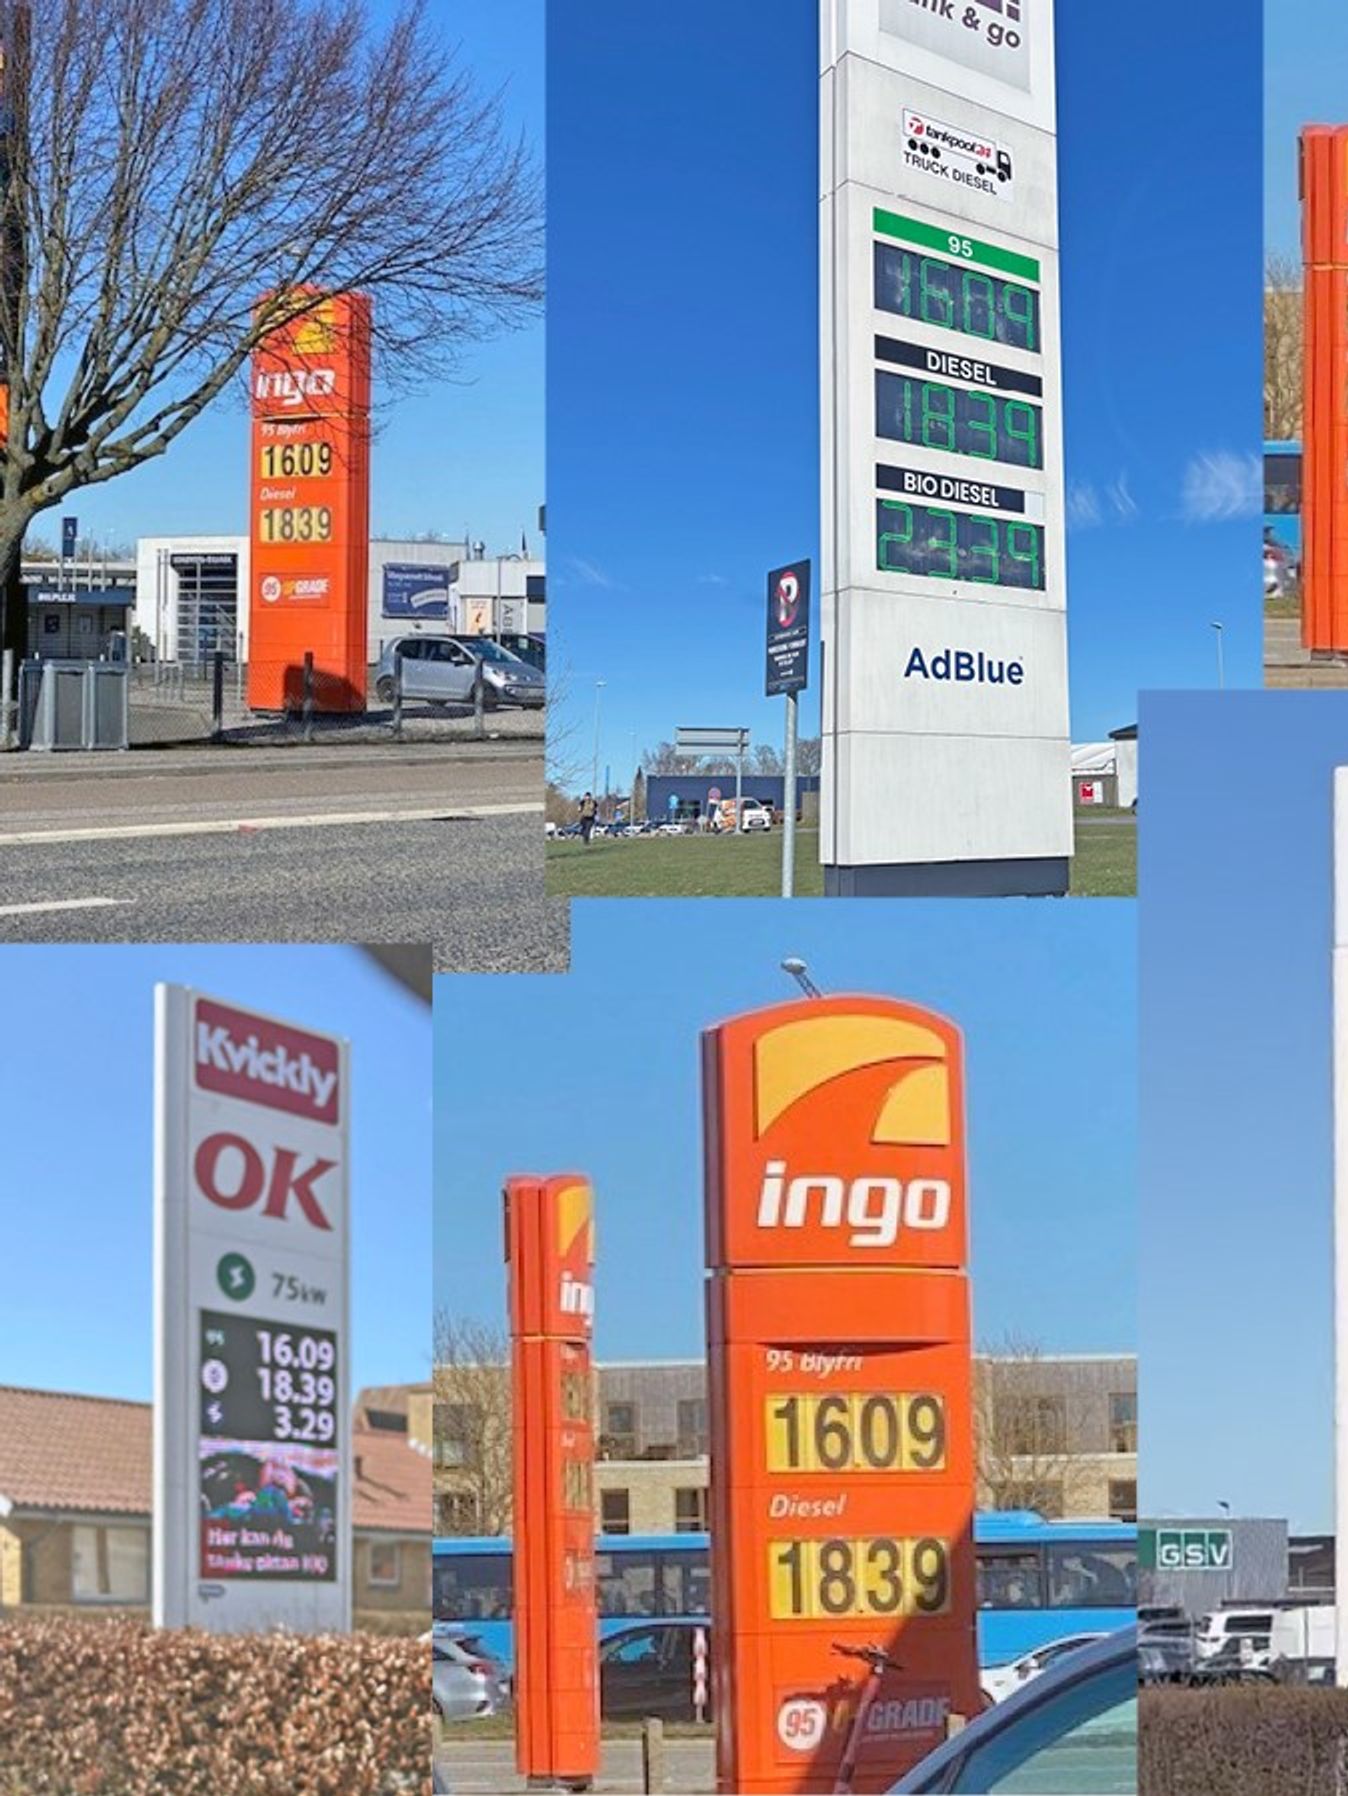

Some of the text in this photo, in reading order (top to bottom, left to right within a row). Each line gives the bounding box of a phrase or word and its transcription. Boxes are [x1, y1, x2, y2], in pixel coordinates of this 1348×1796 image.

[962, 6, 981, 31] &
[987, 22, 1021, 48] go
[904, 151, 997, 196] TRUCK DIESEL
[947, 236, 973, 257] 95
[926, 351, 997, 386] DIESEL
[261, 487, 296, 500] Diesel
[904, 472, 999, 507] BIO DIESEL
[904, 647, 1024, 686] AdBlue
[197, 1021, 337, 1109] Kvickly
[194, 1131, 338, 1232] OK
[757, 1160, 951, 1248] ingo
[560, 1270, 595, 1326] in
[256, 1330, 334, 1372] 16.09
[765, 1350, 792, 1371] 95
[257, 1367, 335, 1407] 18.39
[273, 1404, 335, 1442] 3.29
[769, 1493, 847, 1517] Diesel
[1161, 1543, 1228, 1566] GSV
[786, 1708, 816, 1737] 95
